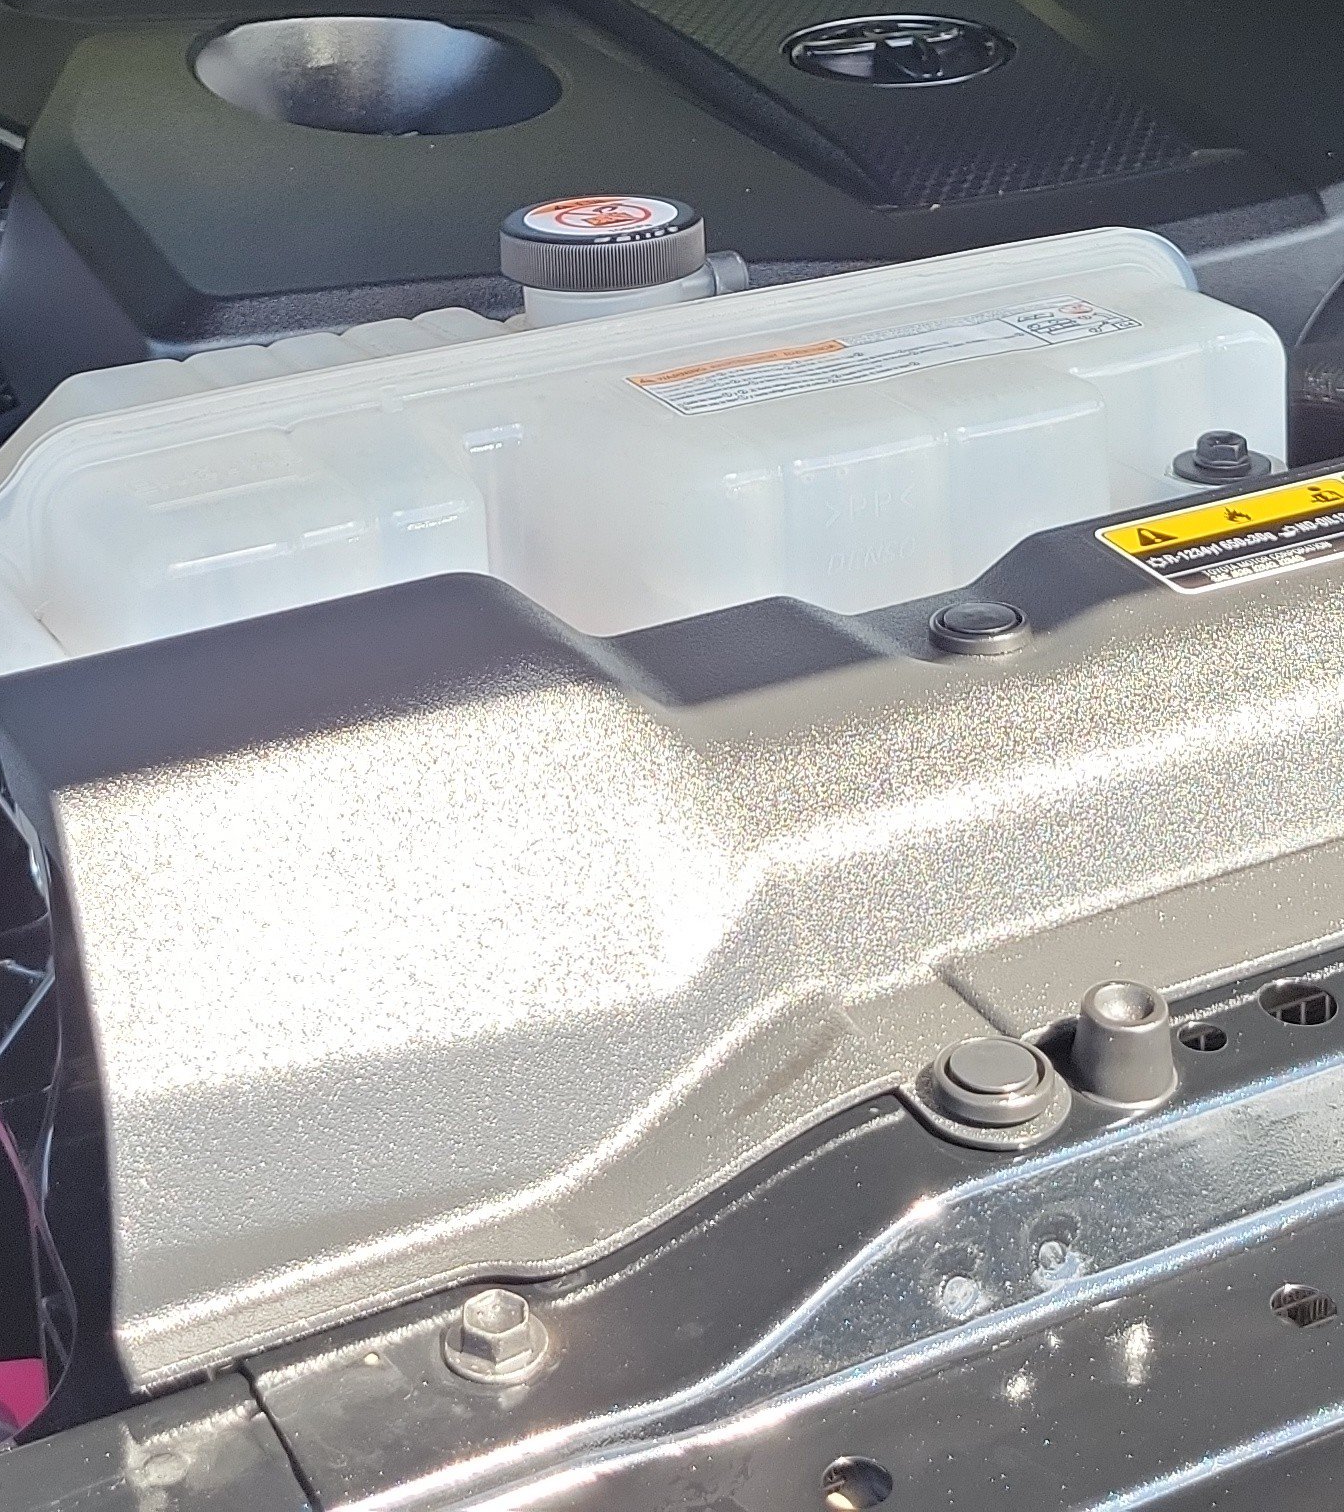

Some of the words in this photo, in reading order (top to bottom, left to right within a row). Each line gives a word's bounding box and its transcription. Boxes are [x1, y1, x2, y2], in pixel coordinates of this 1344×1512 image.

[1201, 563, 1238, 577] TOYOTA
[1238, 555, 1272, 568] MOTOR
[1269, 540, 1333, 559] CORPORATION
